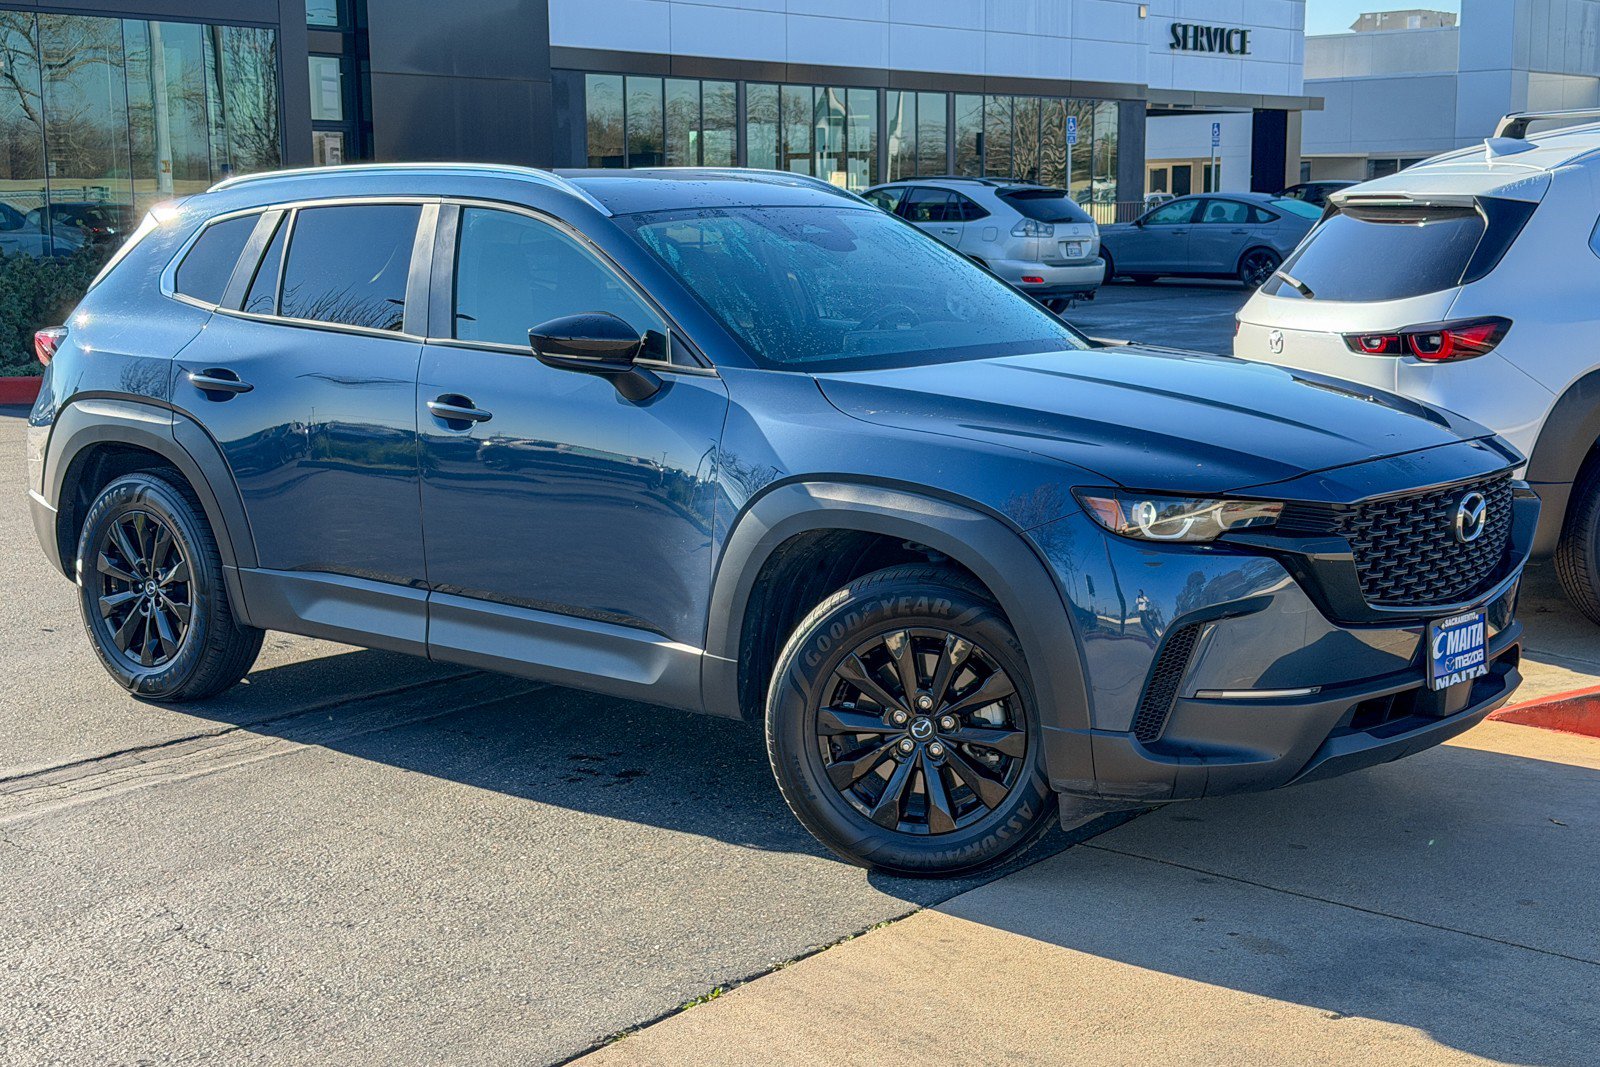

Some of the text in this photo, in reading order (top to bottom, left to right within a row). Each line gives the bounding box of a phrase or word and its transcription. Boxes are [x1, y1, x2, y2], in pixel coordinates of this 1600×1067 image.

[1169, 22, 1252, 55] SERVICE
[1444, 612, 1476, 627] SACRAMENTO
[1446, 622, 1484, 655] MAITA
[1435, 664, 1488, 690] MAITA
